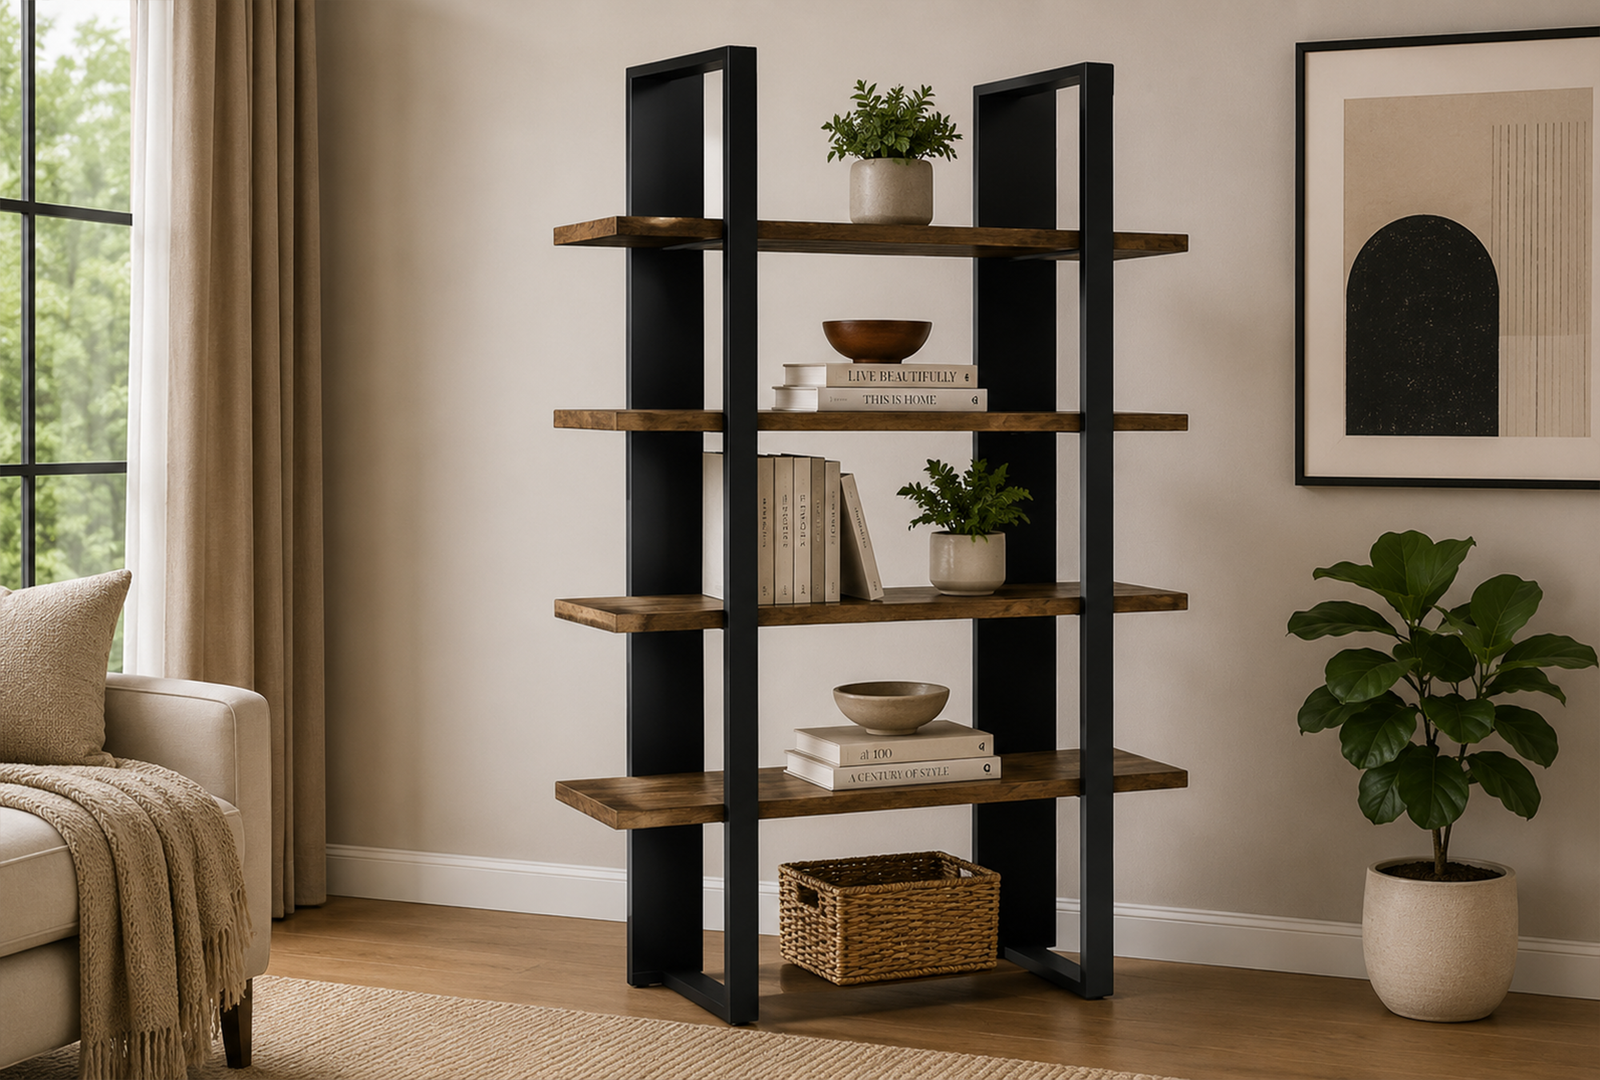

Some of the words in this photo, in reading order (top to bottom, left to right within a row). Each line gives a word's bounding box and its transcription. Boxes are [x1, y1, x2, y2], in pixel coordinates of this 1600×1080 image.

[848, 370, 877, 382] LIVE
[880, 370, 957, 382] BEAUTIFULLY
[863, 395, 890, 405] THIS
[892, 395, 902, 405] IS
[904, 395, 937, 405] HOME
[873, 748, 892, 760] 100
[848, 774, 856, 783] A
[858, 770, 902, 782] CENTURY
[905, 769, 917, 779] OF
